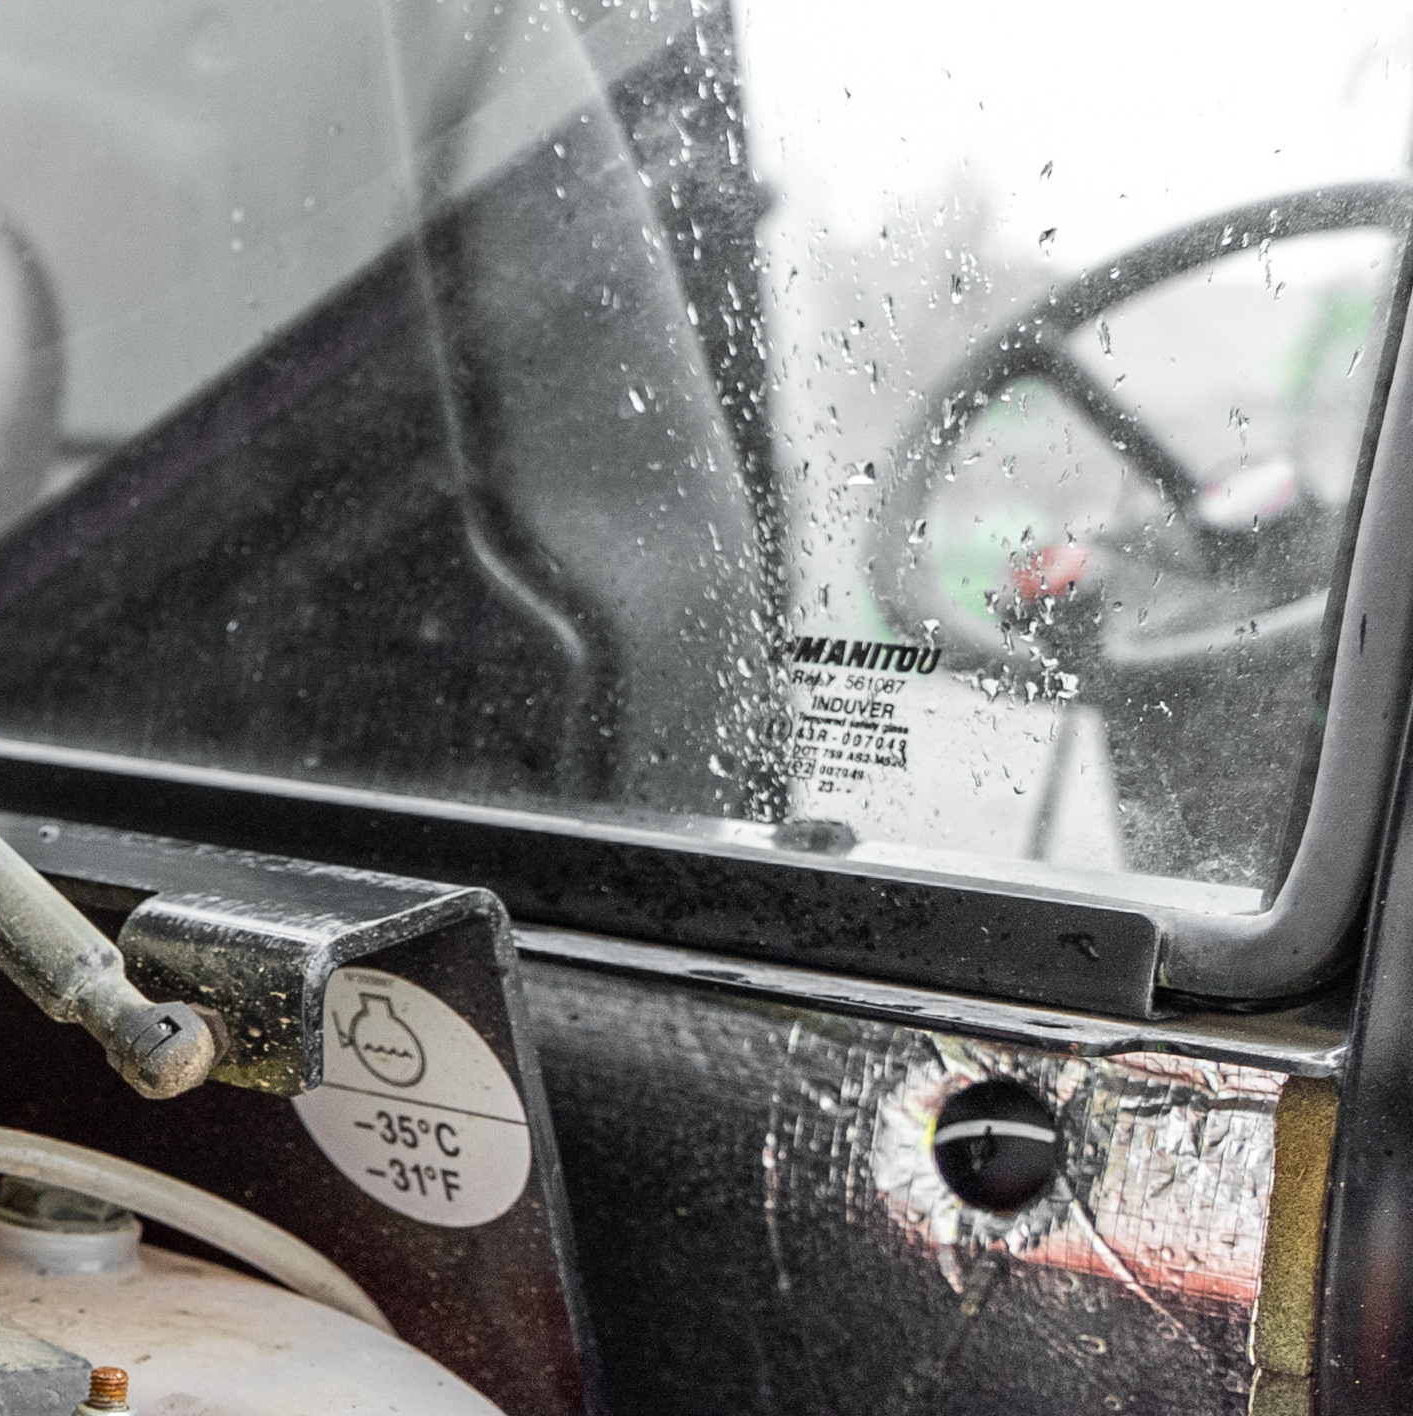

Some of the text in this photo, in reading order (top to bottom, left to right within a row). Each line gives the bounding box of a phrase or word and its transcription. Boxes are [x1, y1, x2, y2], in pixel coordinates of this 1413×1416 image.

[790, 636, 942, 675] MANITOU
[844, 674, 906, 694] 561087
[812, 695, 894, 719] INDUVER
[354, 1110, 463, 1158] -35°C
[366, 1158, 463, 1202] -31°F
